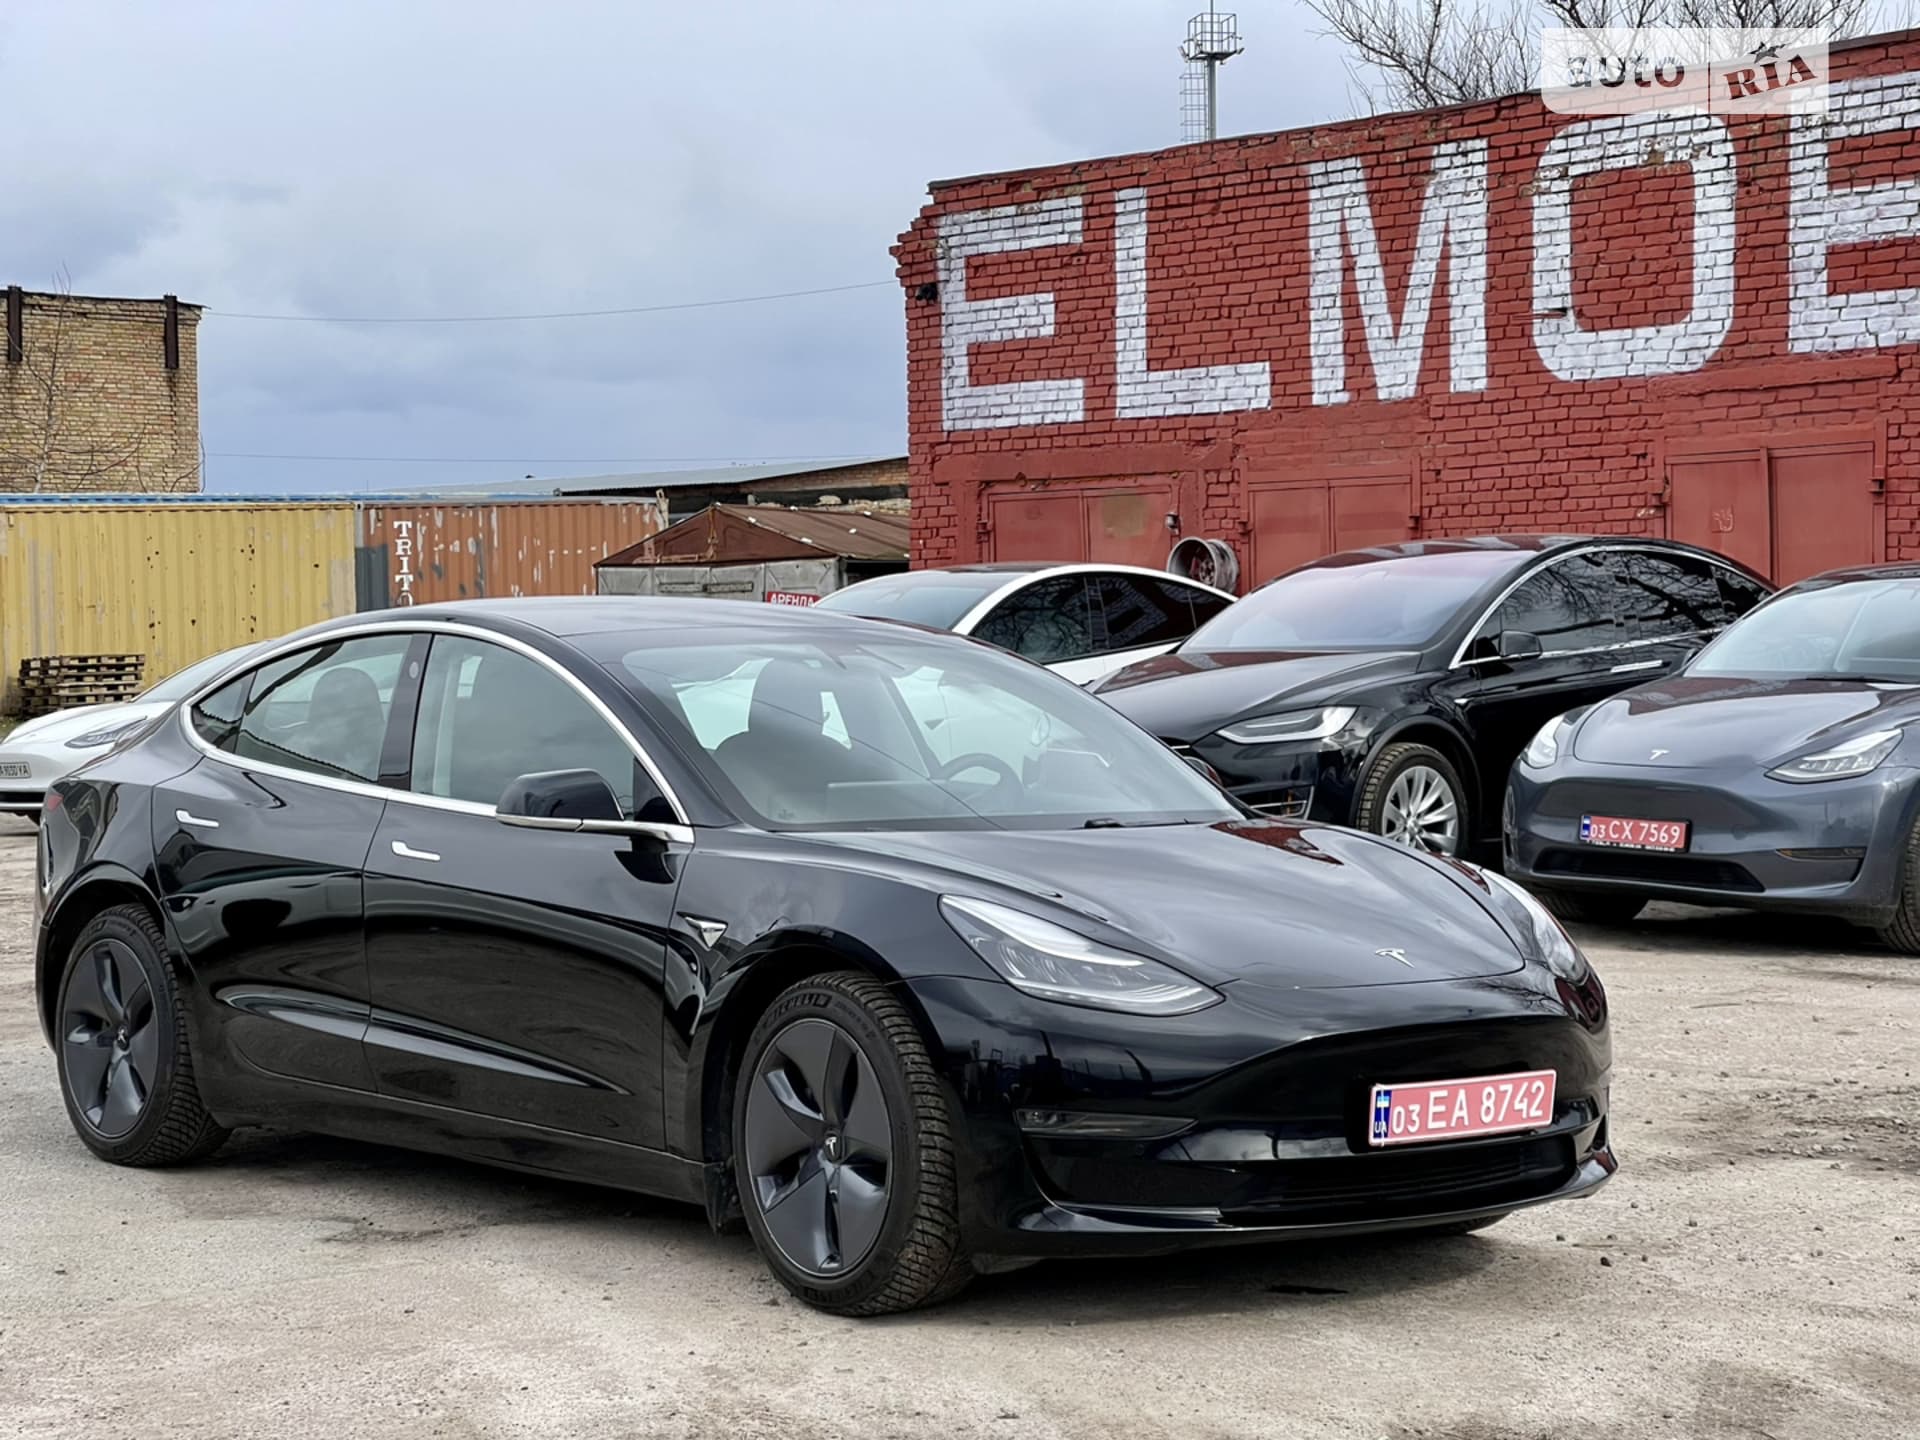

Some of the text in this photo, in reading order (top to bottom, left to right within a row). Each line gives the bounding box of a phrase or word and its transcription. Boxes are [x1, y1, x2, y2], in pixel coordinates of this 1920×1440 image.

[1591, 820, 1680, 844] 03 CX 7569
[1392, 1104, 1421, 1134] 03
[1427, 1089, 1469, 1129] EA
[1480, 1080, 1545, 1124] 8742
